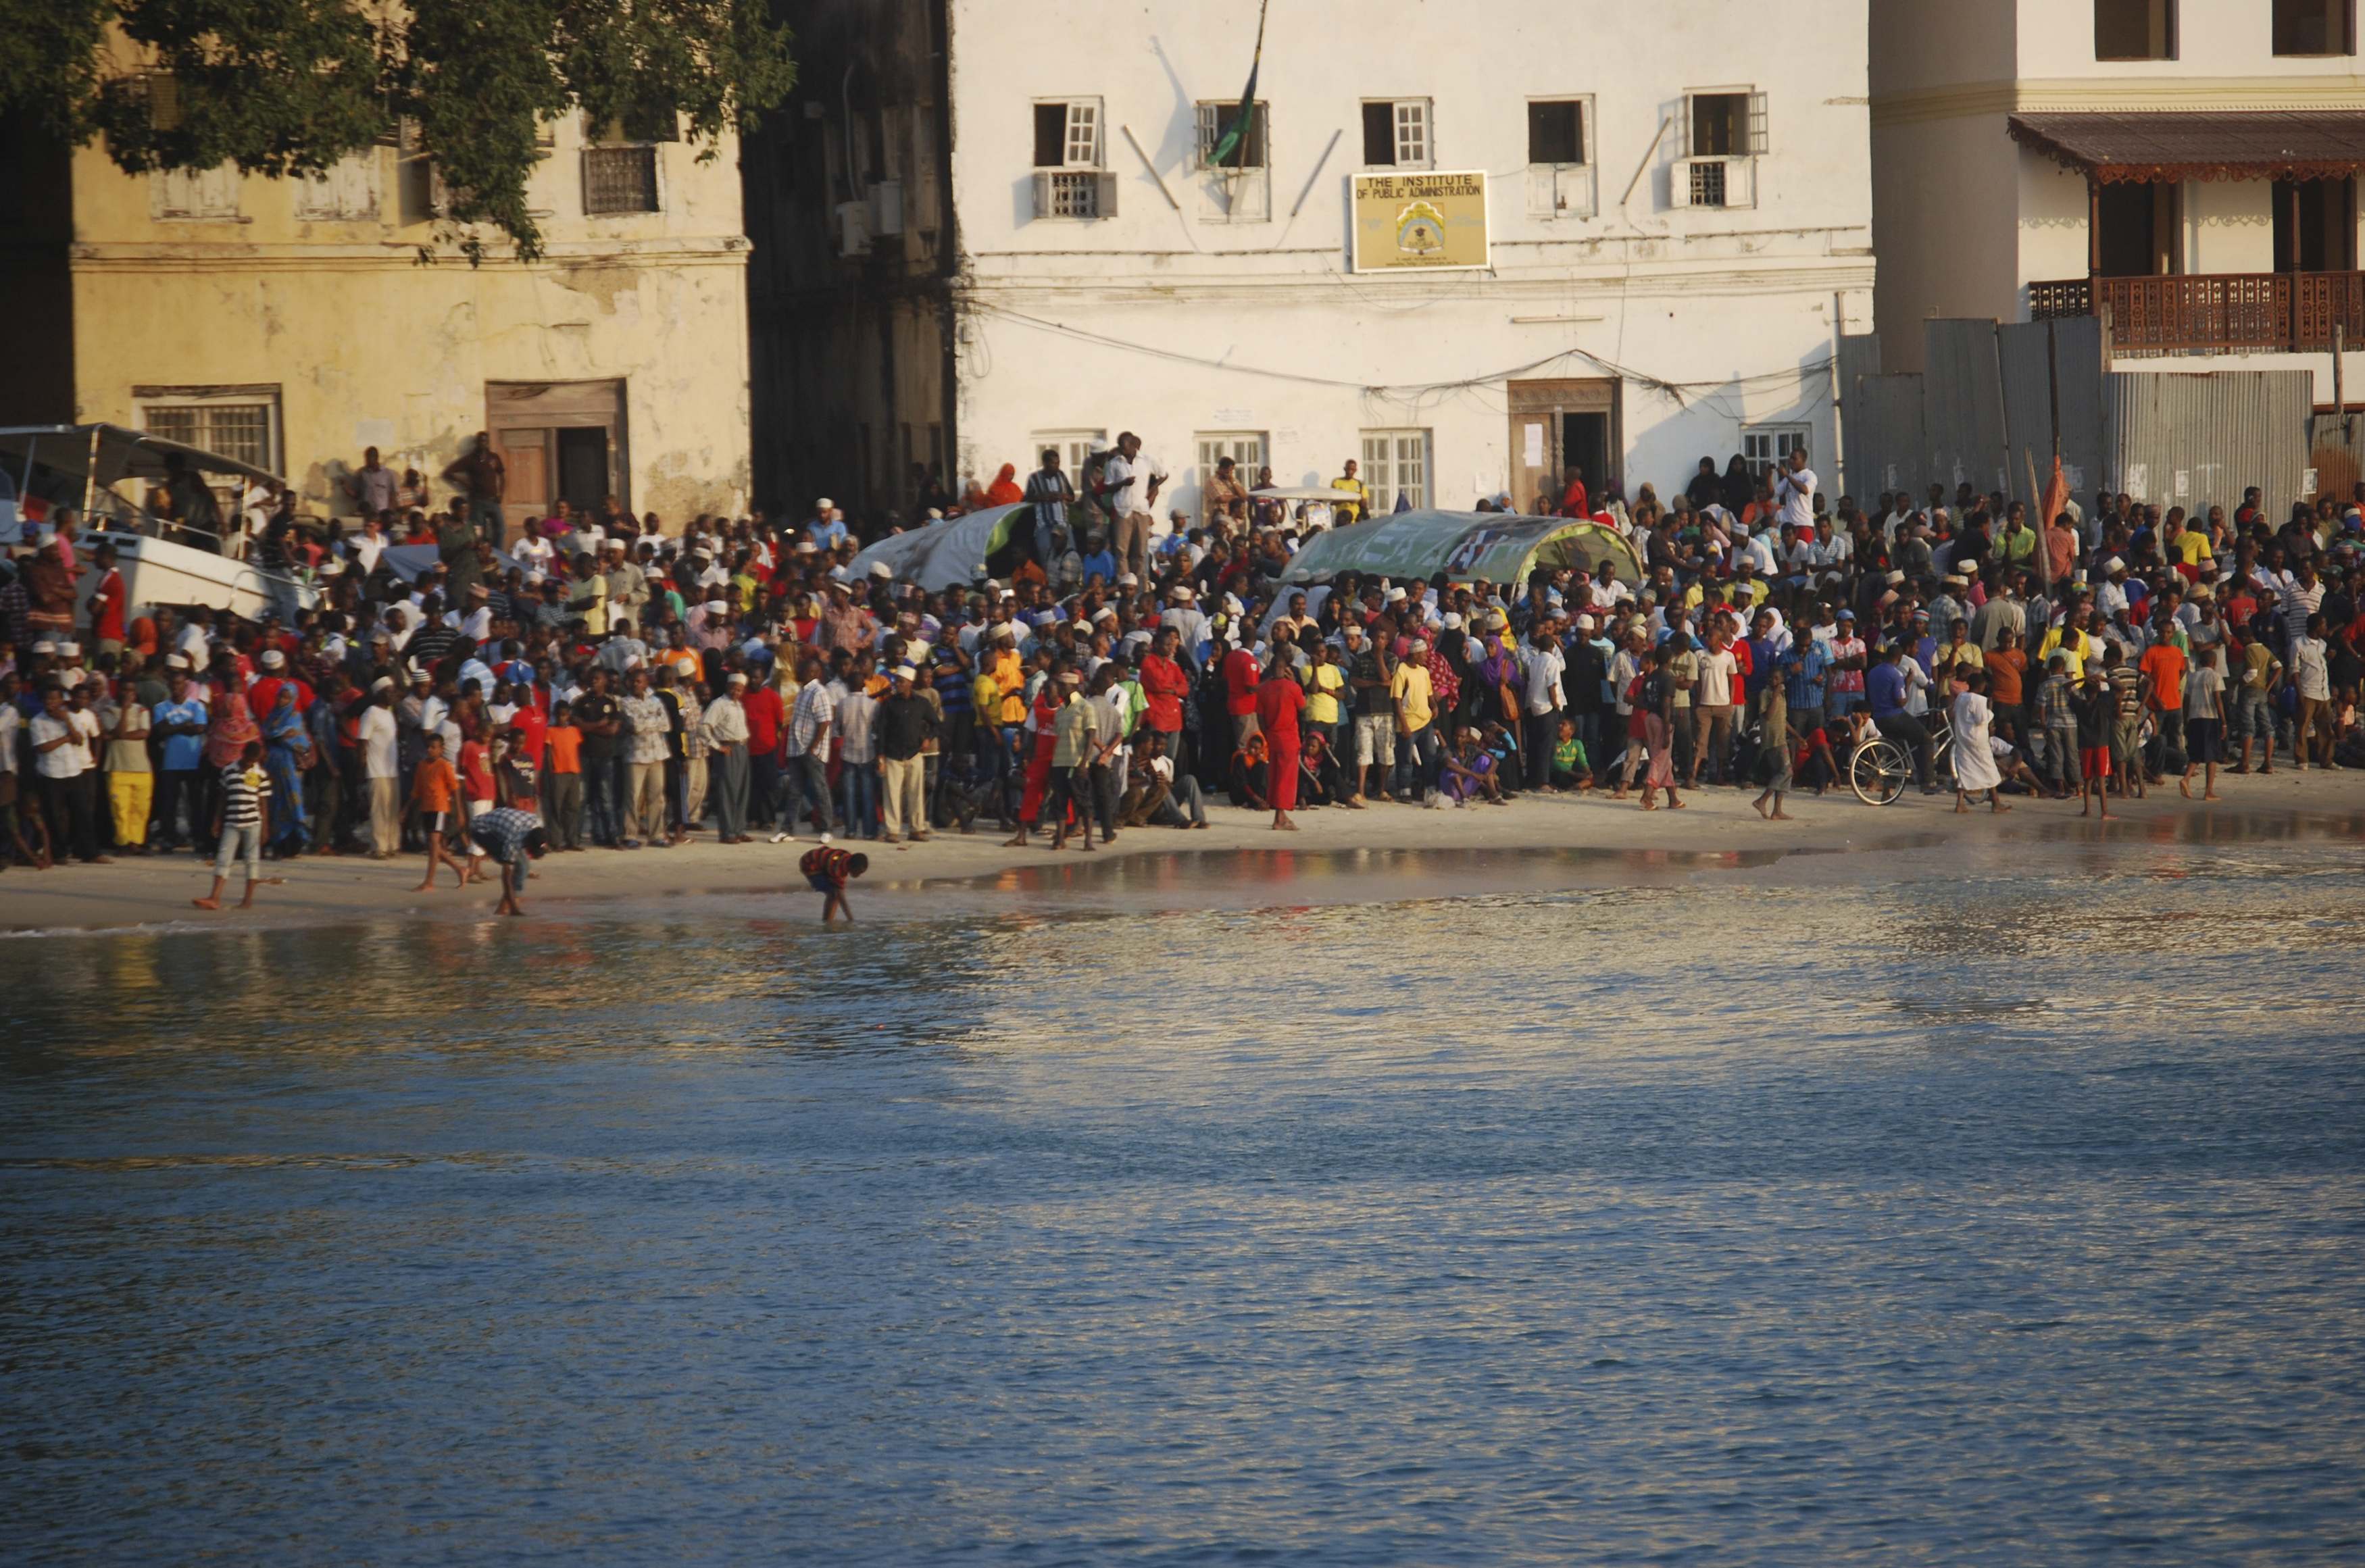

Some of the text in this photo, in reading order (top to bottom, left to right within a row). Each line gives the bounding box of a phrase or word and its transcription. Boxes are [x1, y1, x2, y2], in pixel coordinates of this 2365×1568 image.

[1367, 174, 1473, 188] THE INSTITUTE
[1356, 184, 1481, 199] OF PUBLIC ADMINISTRATION
